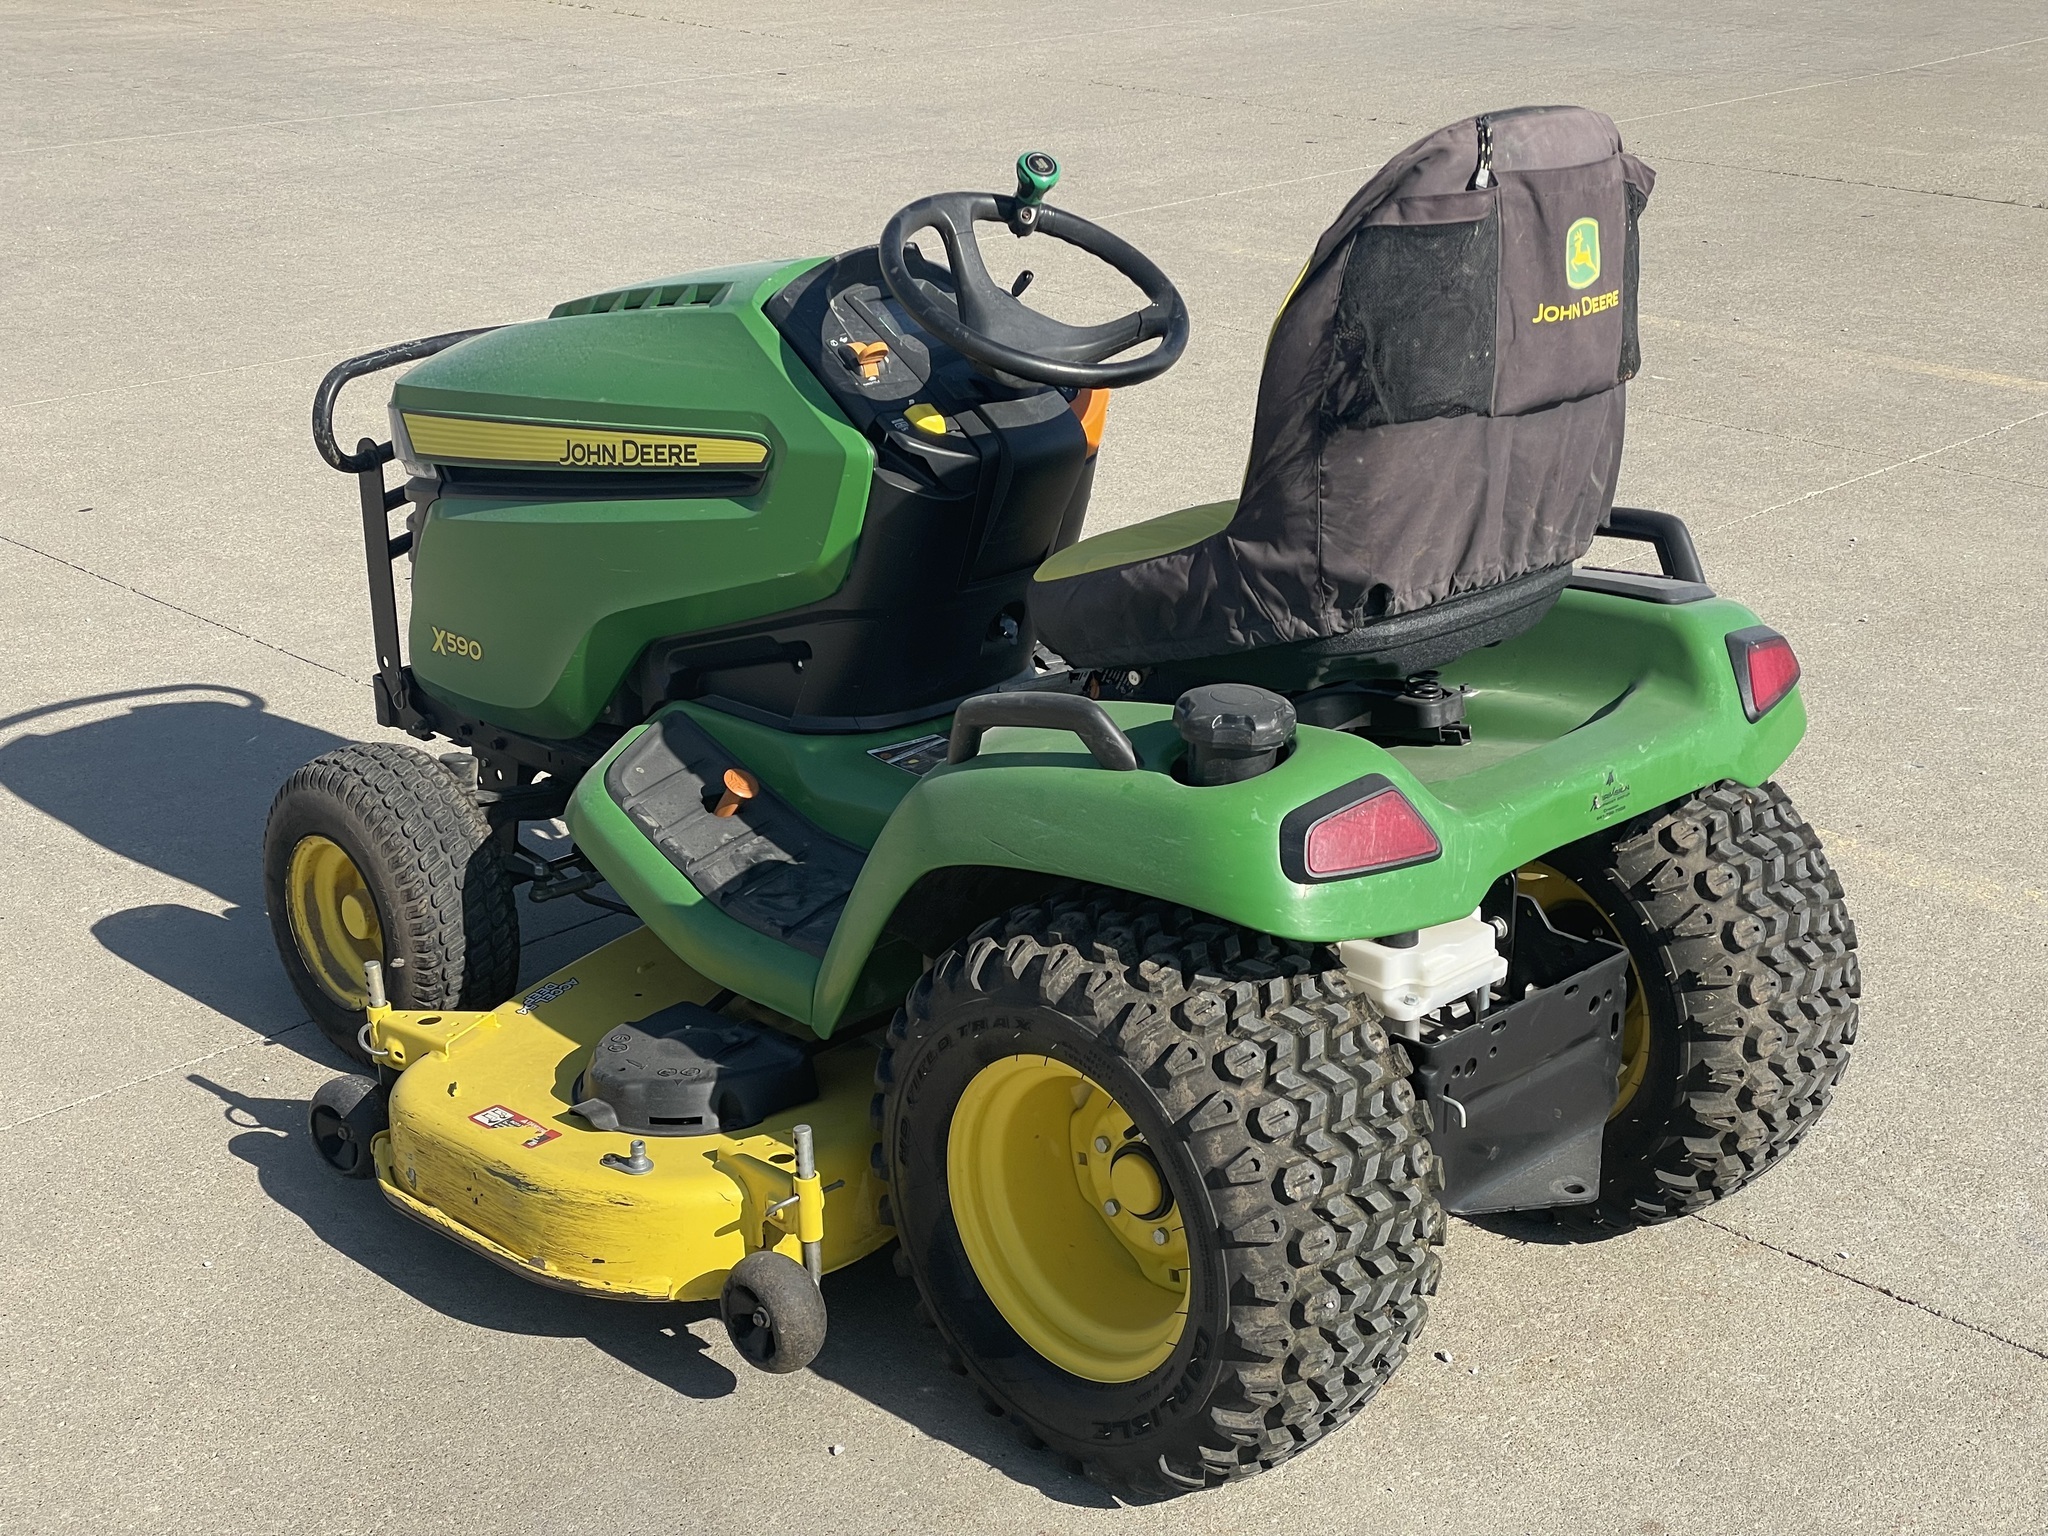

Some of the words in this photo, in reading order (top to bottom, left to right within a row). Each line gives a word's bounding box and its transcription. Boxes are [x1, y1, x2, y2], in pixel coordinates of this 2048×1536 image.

[1532, 302, 1580, 324] JOHN
[1581, 289, 1620, 316] DEERE
[559, 439, 617, 464] JOHN
[622, 439, 698, 464] DEERE
[431, 626, 482, 660] X590
[523, 982, 559, 1005] DEEP
[539, 977, 579, 1003] ACCEL
[956, 1015, 1034, 1039] TRAX
